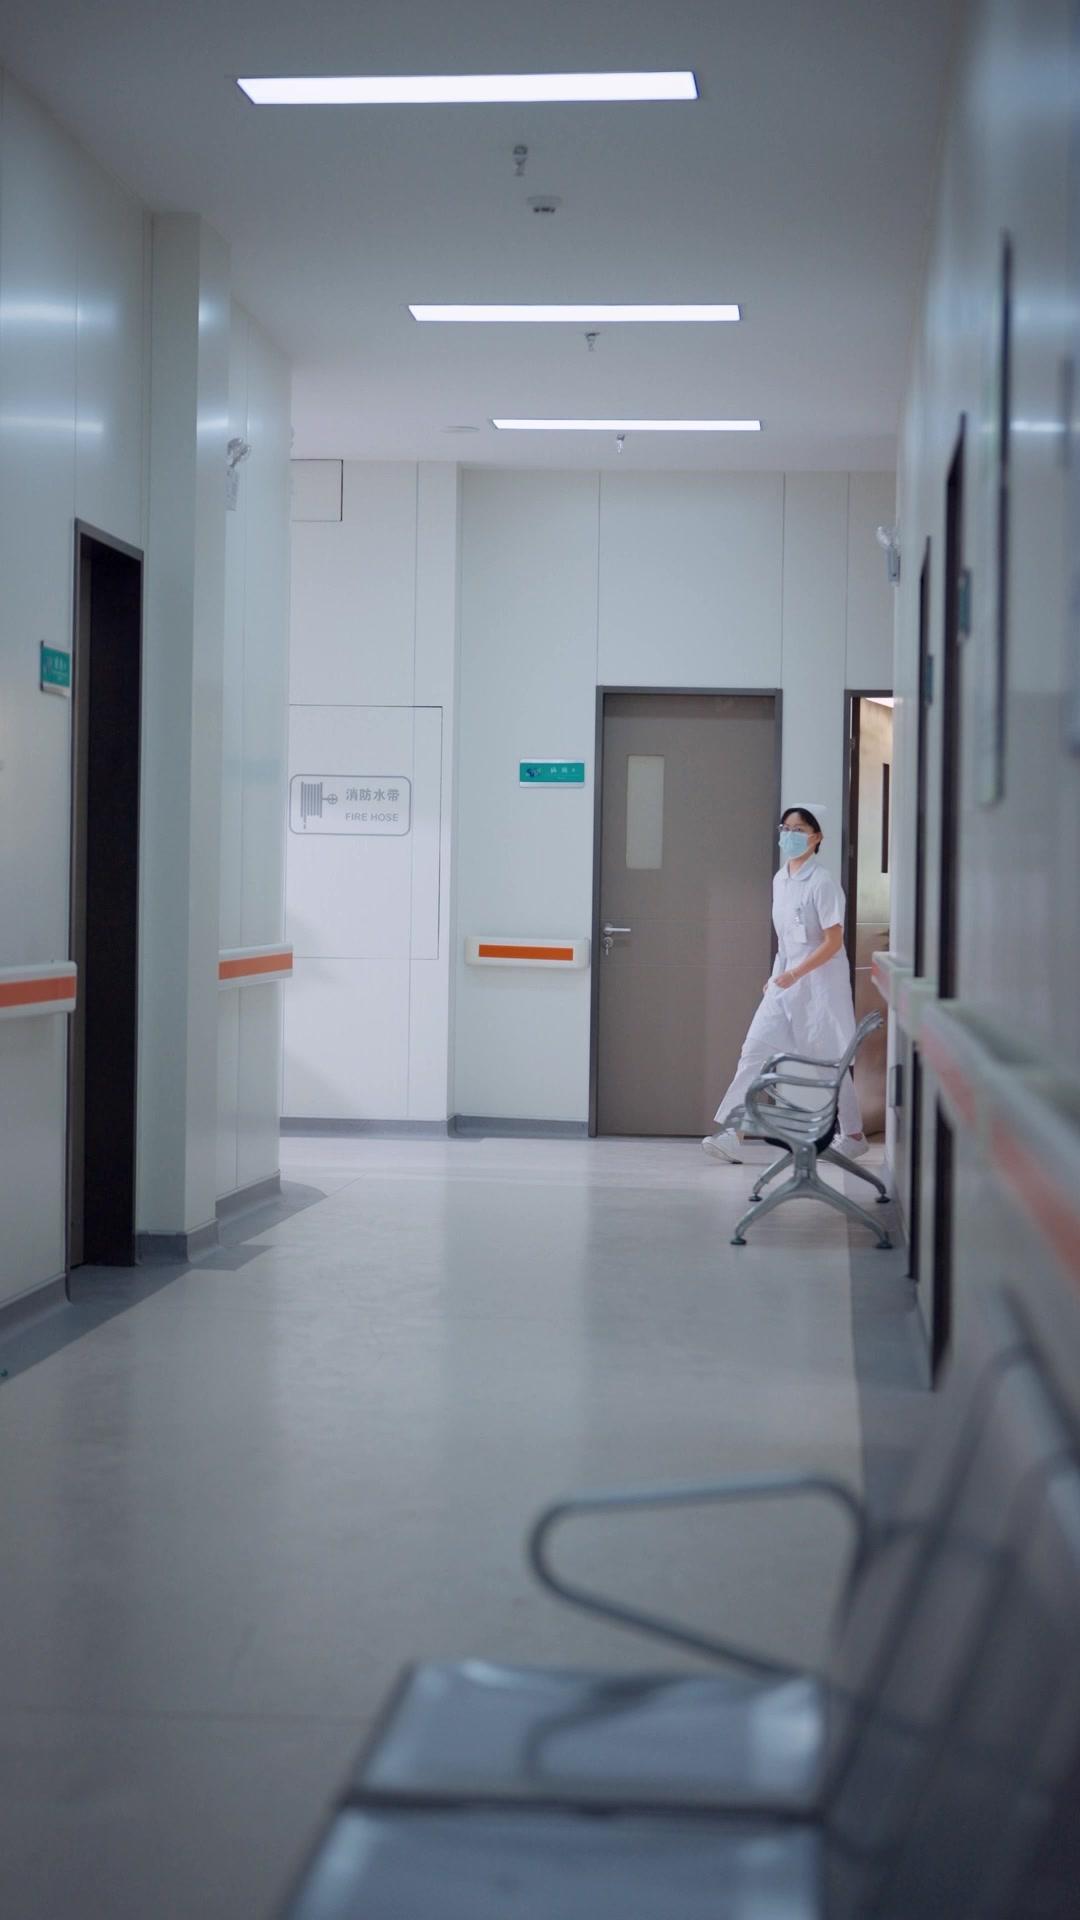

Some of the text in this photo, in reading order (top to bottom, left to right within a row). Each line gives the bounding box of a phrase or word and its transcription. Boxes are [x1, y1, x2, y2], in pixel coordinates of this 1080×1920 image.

[346, 788, 400, 801] 消防水带
[345, 812, 399, 822] FIRE HOSE
